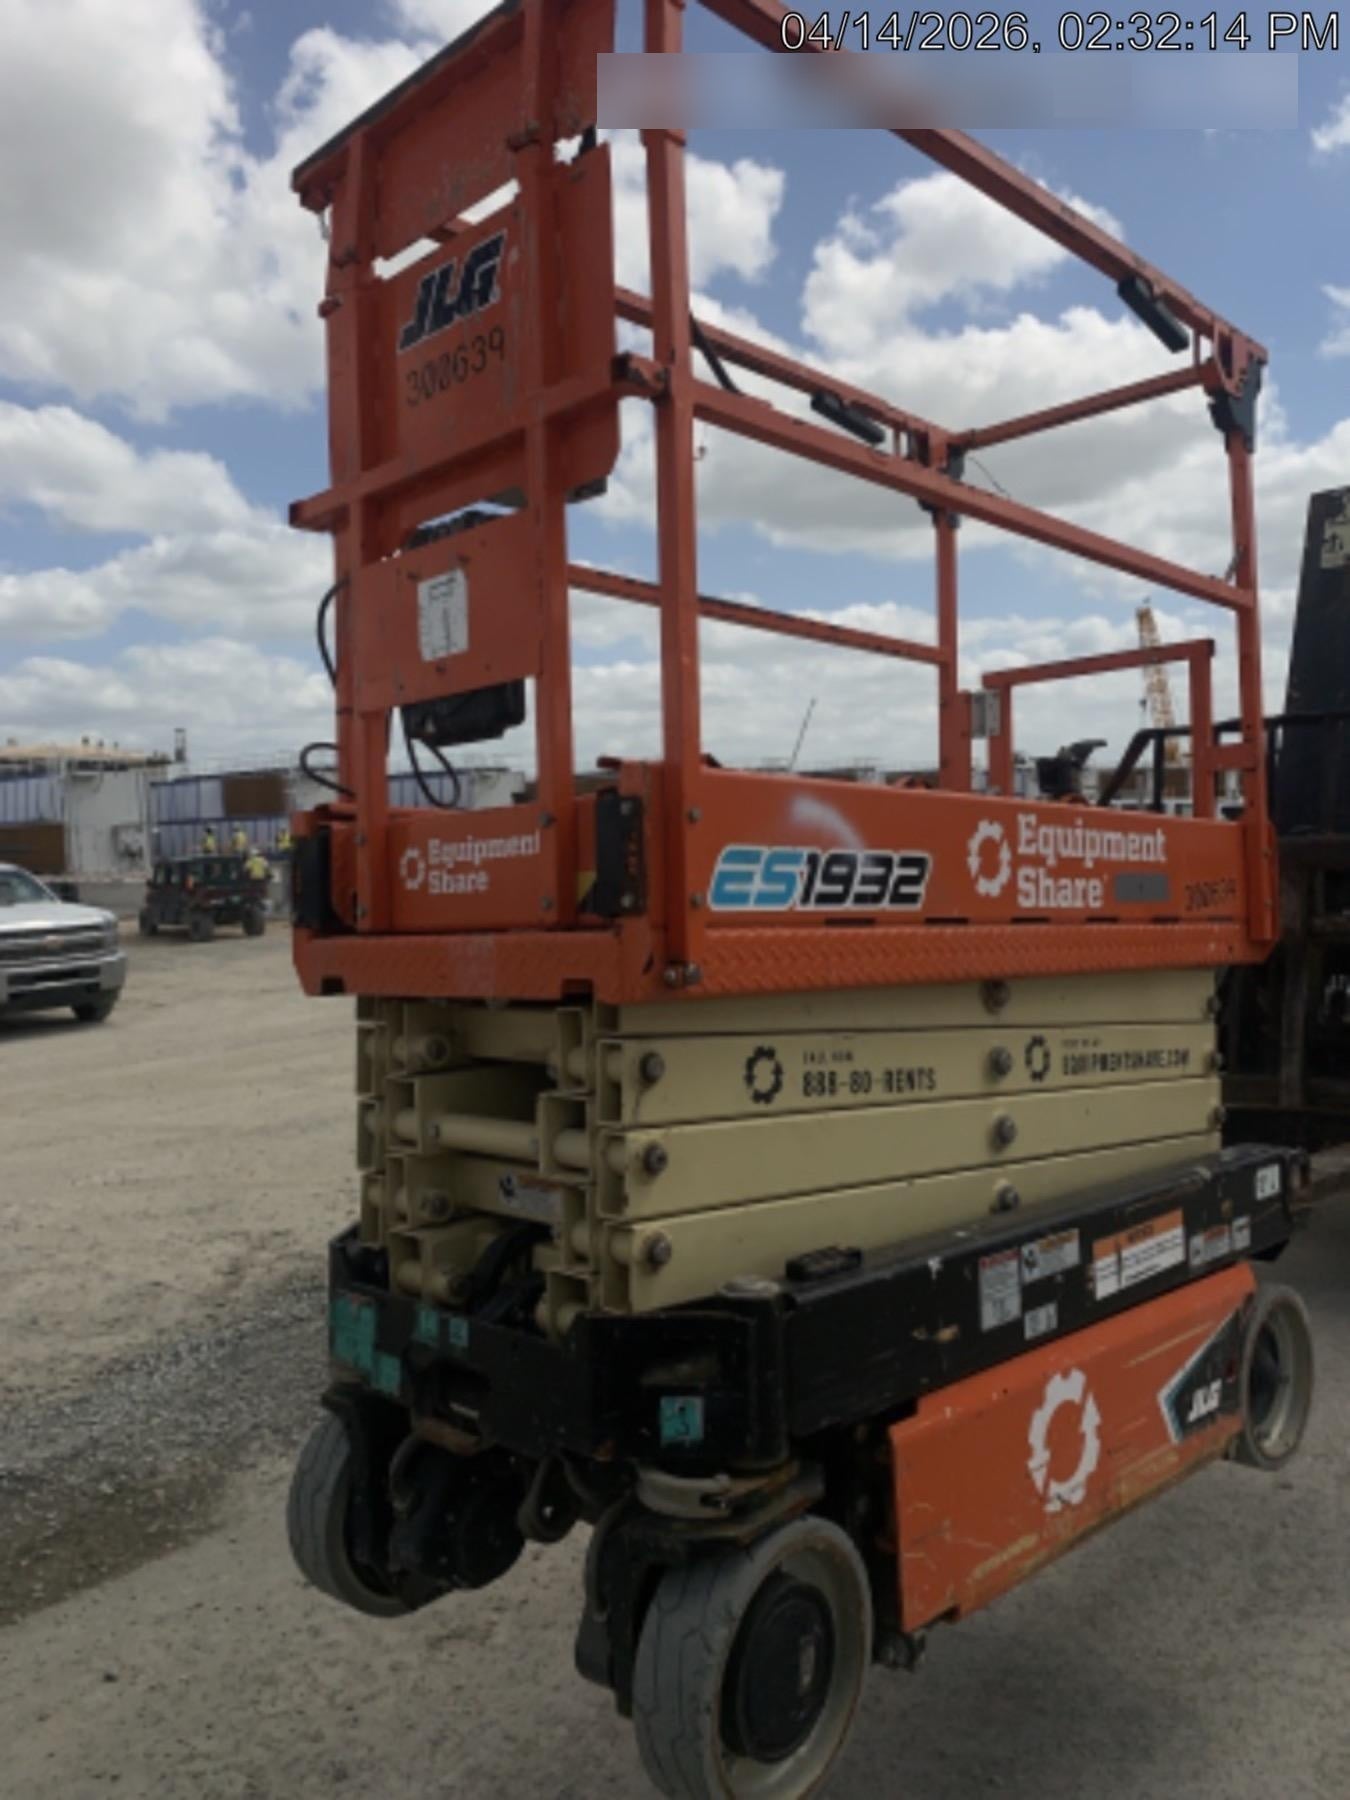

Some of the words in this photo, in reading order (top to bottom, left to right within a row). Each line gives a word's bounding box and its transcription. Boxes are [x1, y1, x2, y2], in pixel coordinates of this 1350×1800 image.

[398, 229, 507, 353] JLG
[428, 831, 541, 868] Equipment
[1017, 813, 1167, 869] Equipment
[428, 870, 490, 895] Share
[708, 844, 932, 911] ES1932
[1017, 867, 1103, 908] Share
